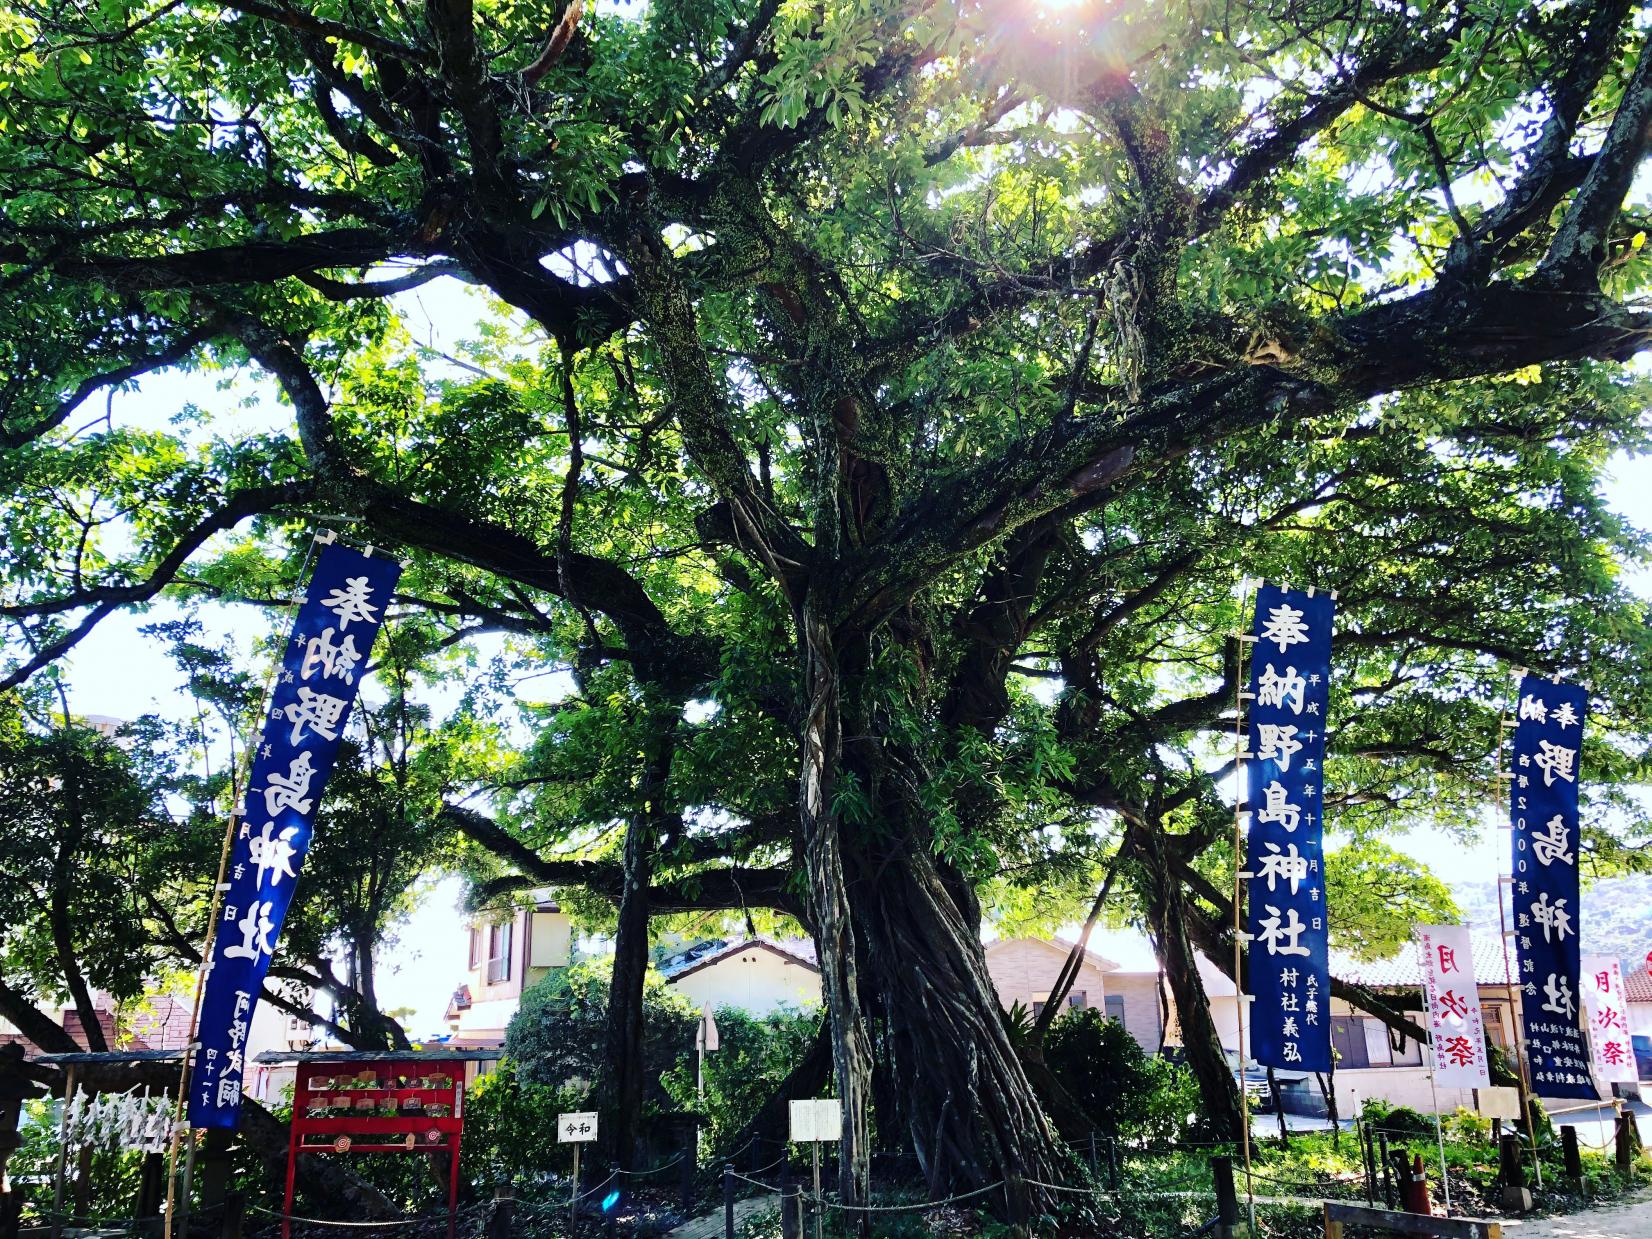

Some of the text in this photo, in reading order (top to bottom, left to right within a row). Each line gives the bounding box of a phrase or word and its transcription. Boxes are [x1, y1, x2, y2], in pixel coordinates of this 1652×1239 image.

[1257, 604, 1311, 956] 奉納野島神社
[1303, 674, 1322, 930] 平成十五年十一月吉日
[1280, 968, 1302, 1063] 村社義弘
[1595, 971, 1625, 1066] 月次祭
[565, 1122, 591, 1137] 令和
